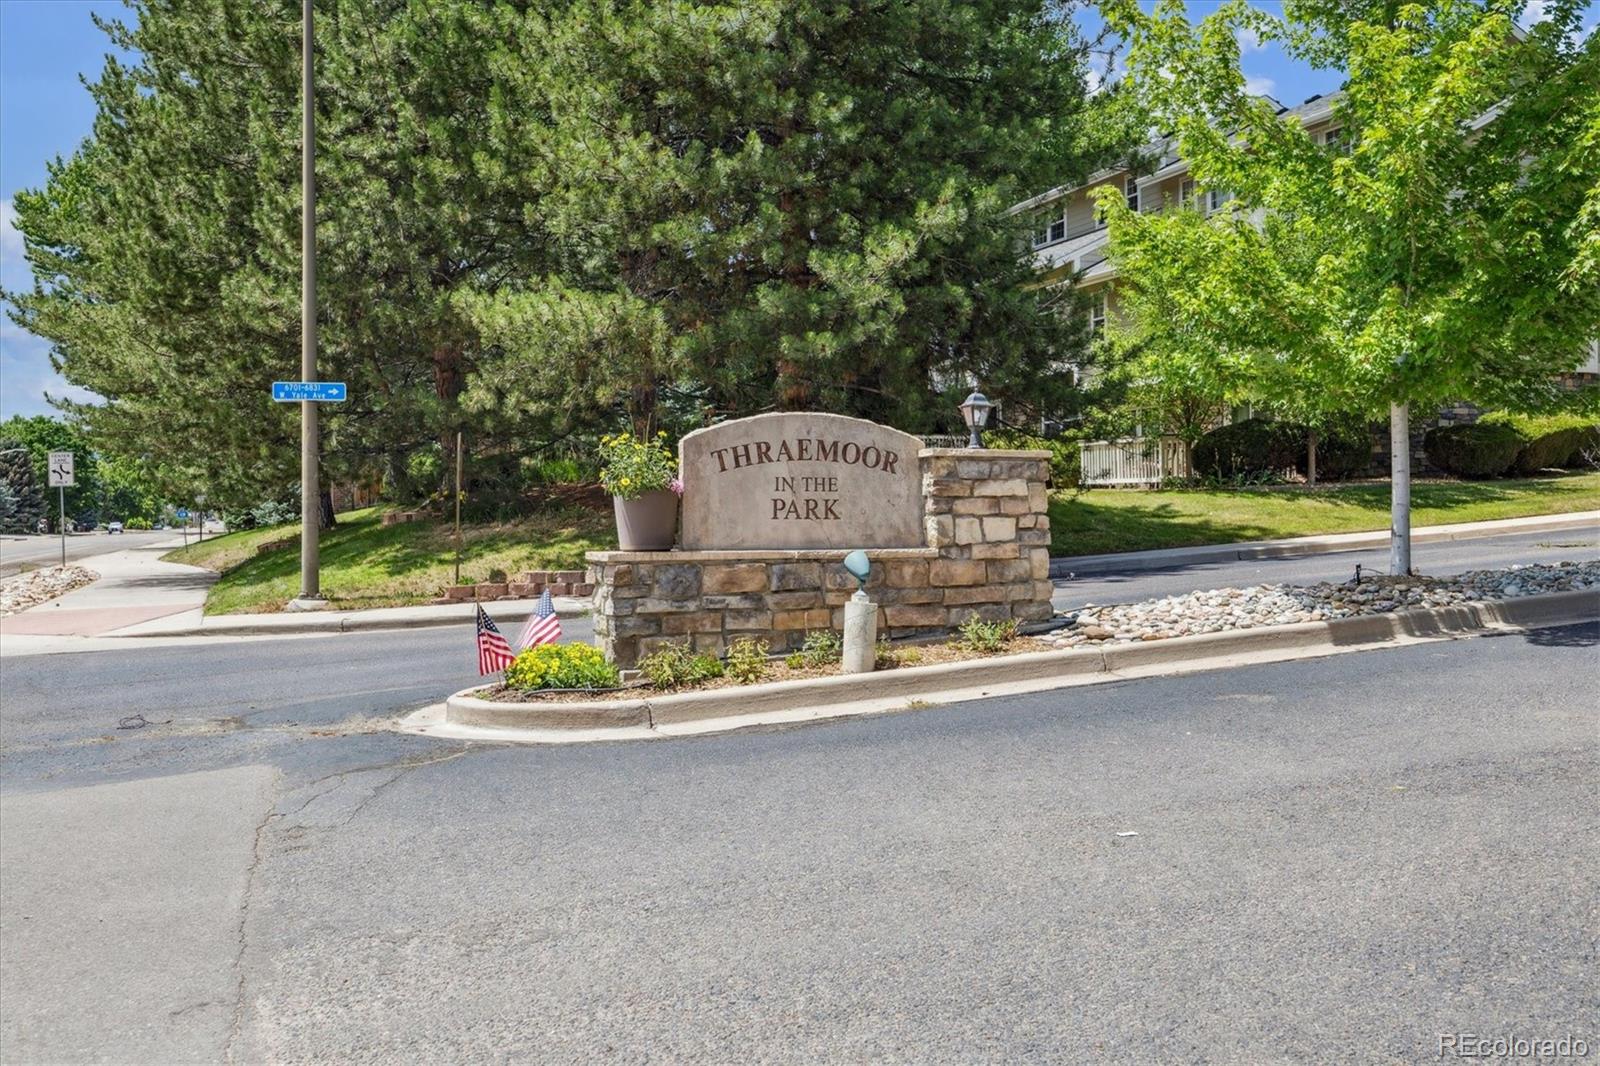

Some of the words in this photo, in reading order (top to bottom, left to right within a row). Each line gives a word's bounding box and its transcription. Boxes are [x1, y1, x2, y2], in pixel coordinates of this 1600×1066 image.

[291, 391, 308, 399] Yale
[710, 438, 899, 474] THRAEMOOR
[774, 476, 795, 493] IN
[801, 477, 839, 492] THE
[770, 498, 841, 520] PARK
